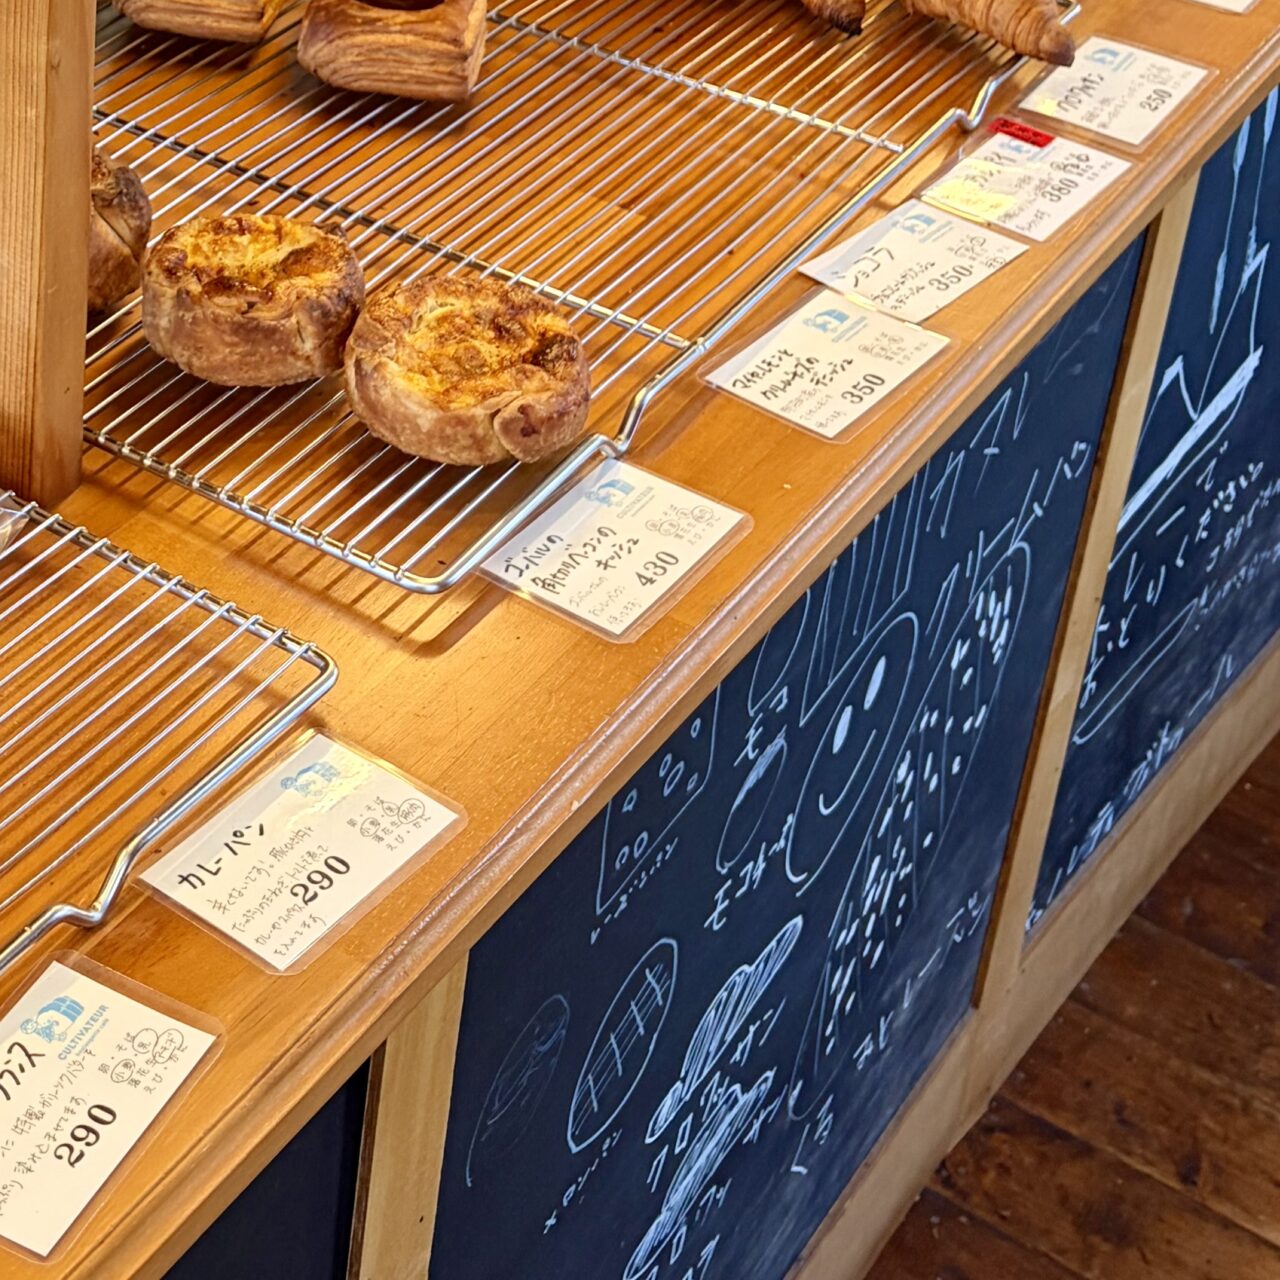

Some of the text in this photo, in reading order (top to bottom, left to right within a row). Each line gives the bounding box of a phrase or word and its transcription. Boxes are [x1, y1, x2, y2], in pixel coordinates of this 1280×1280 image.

[1139, 88, 1173, 112] 250
[1040, 178, 1079, 203] 380
[928, 265, 973, 291] 350
[841, 373, 886, 404] 350
[635, 551, 679, 587] 430
[178, 823, 265, 890] カレーパン
[290, 855, 350, 906] 290
[57, 1004, 109, 1061] CULTIVATEUR
[54, 1104, 117, 1168] 290
[544, 1128, 622, 1235] メロンパン
